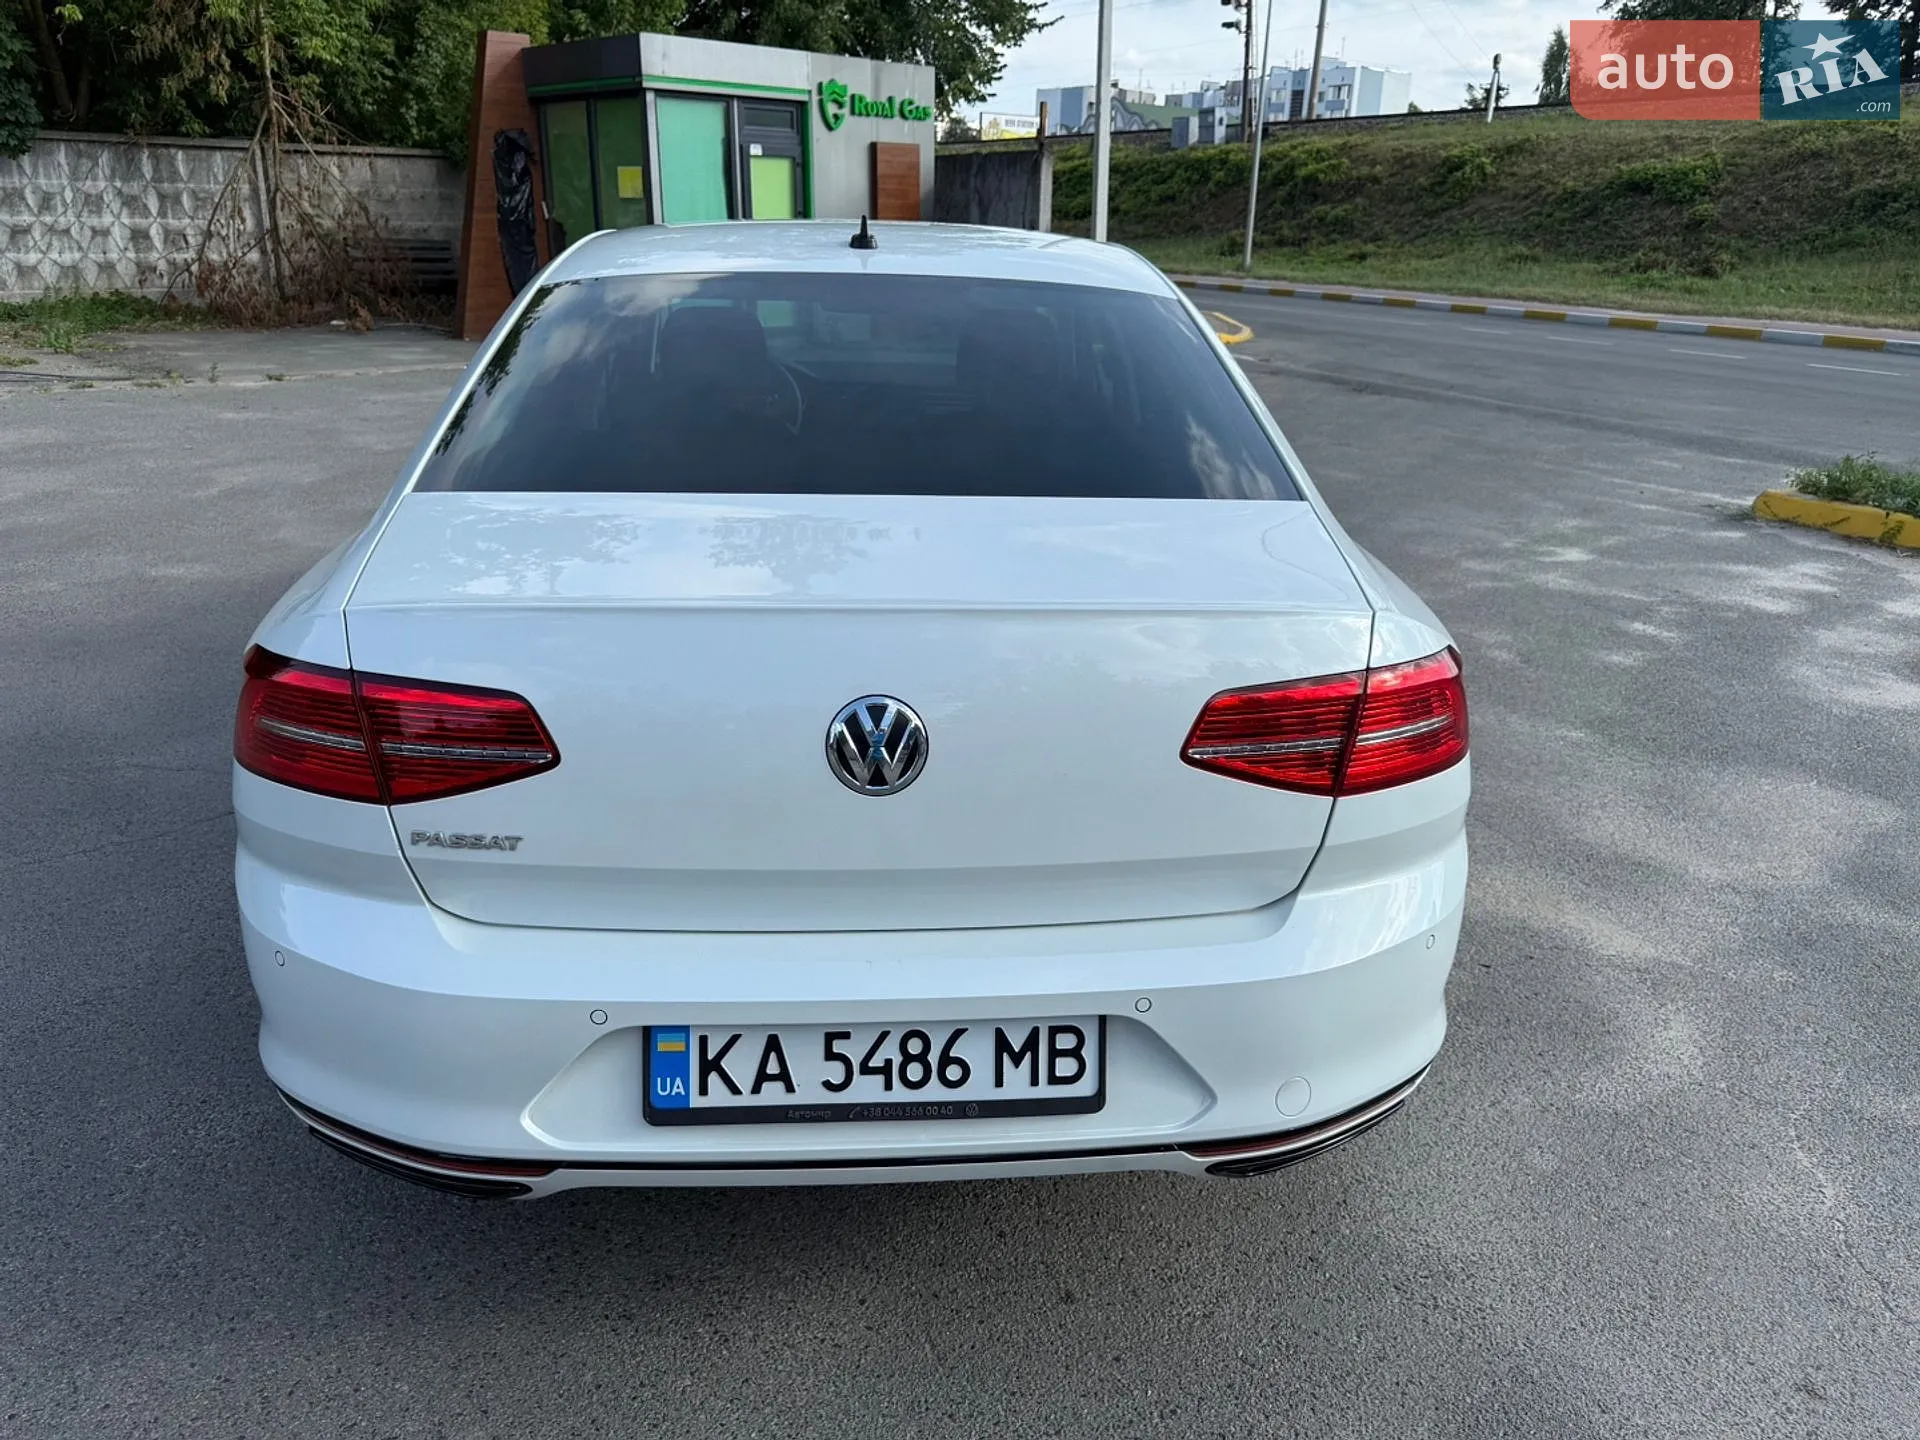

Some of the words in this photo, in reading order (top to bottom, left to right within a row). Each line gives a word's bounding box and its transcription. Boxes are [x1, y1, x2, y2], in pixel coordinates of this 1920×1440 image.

[411, 830, 525, 851] PASSAT
[656, 1077, 686, 1096] UA
[698, 1033, 797, 1096] KA
[821, 1028, 972, 1093] 5486
[994, 1025, 1087, 1088] MB
